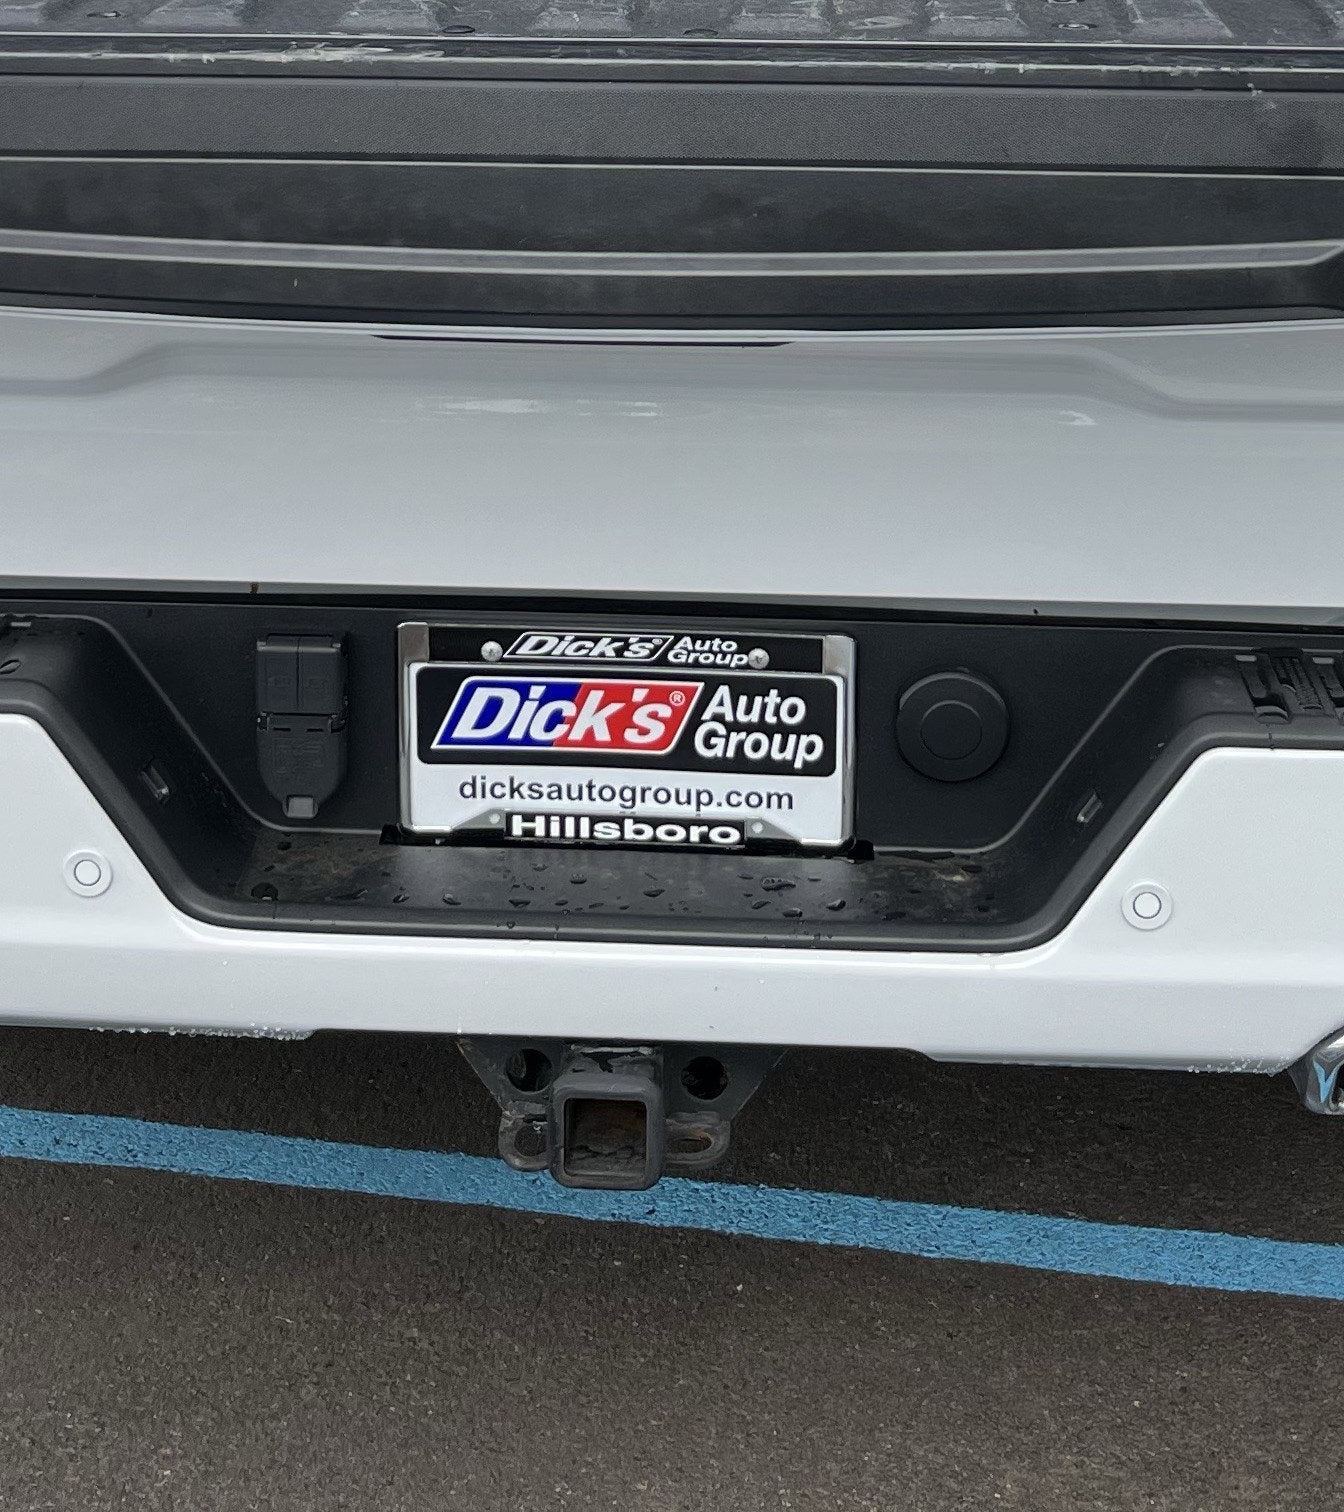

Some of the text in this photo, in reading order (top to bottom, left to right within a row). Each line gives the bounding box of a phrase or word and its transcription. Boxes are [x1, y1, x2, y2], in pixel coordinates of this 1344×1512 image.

[515, 634, 737, 659] Dick's Auto
[667, 649, 750, 668] Group
[451, 684, 806, 744] Dick's Auto
[694, 721, 824, 769] Group
[459, 775, 794, 810] dicksautogroup.com
[511, 814, 742, 845] Hillsboro
